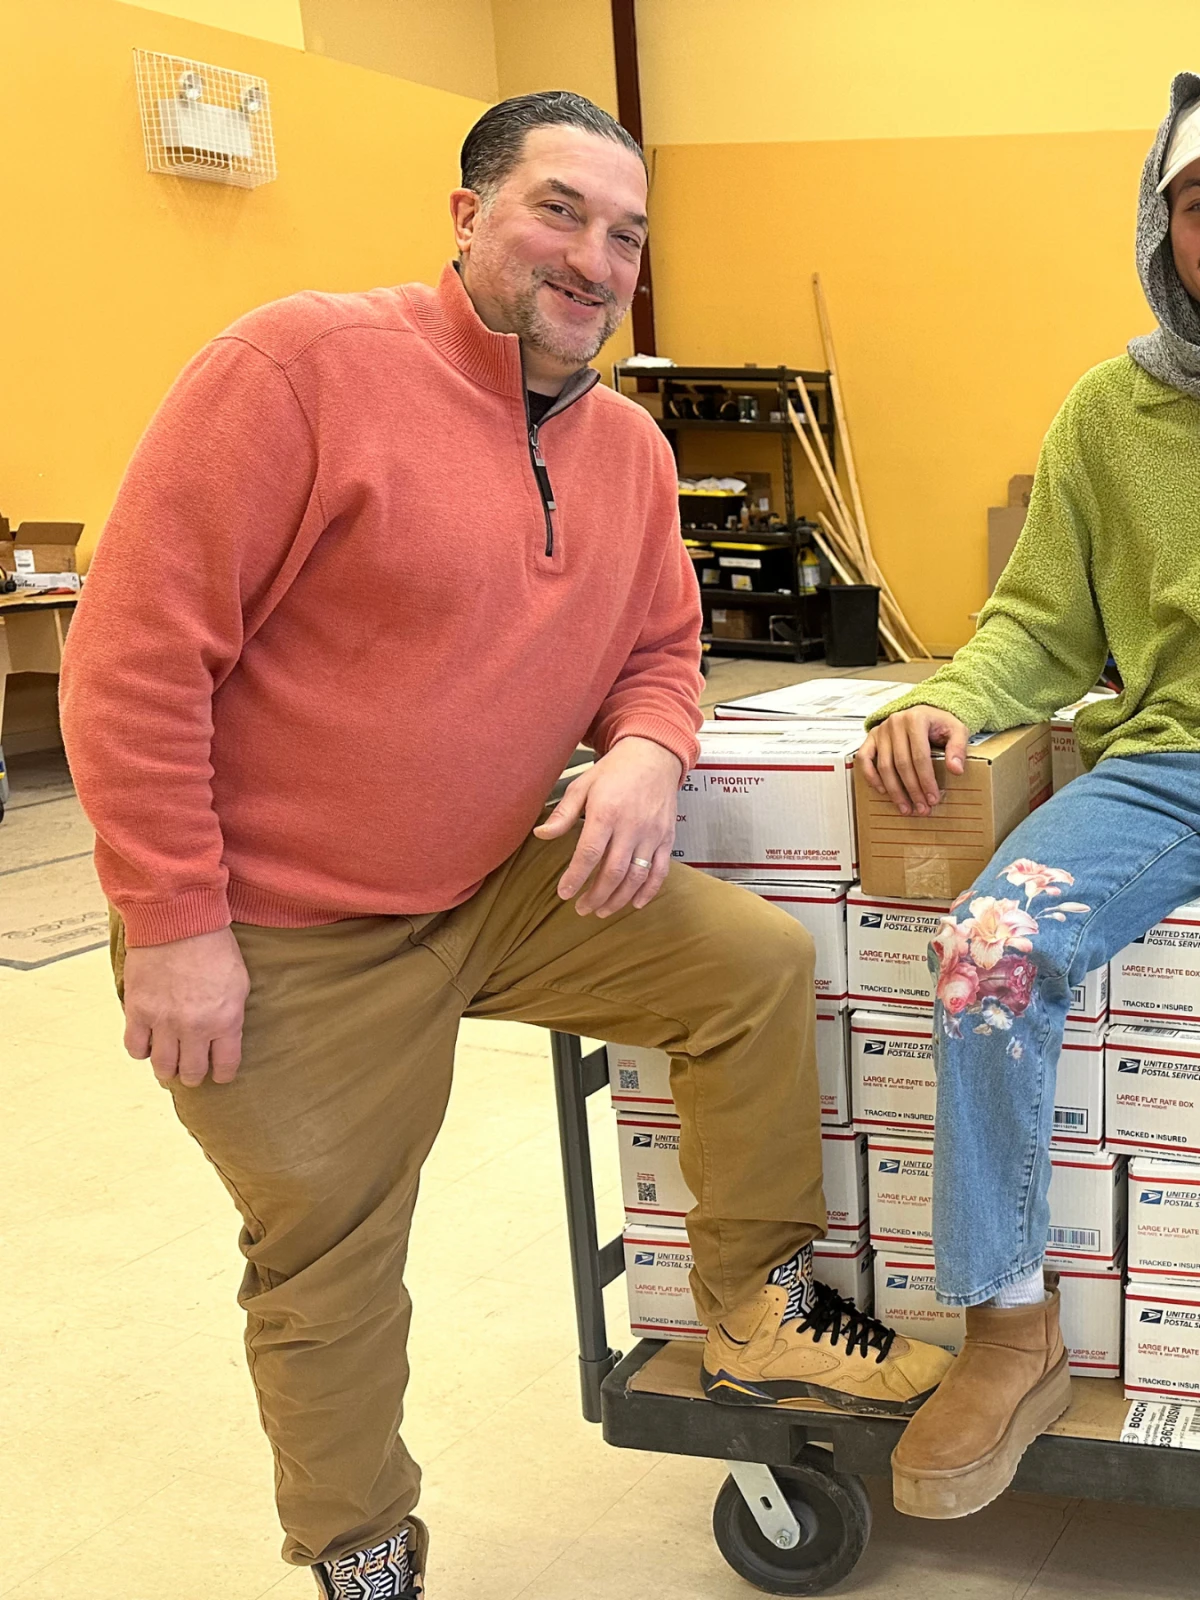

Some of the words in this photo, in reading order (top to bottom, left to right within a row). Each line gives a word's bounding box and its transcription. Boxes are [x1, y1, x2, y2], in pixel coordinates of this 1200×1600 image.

[1149, 929, 1180, 938] UNITED
[1147, 938, 1176, 947] POSTAL
[1122, 964, 1145, 972] LARGE
[861, 985, 893, 994] TRACKED
[900, 988, 930, 997] INSURED
[1144, 1060, 1174, 1069] UNITED
[1141, 1068, 1170, 1078] POSTAL
[1166, 1191, 1197, 1199] UNITED
[1164, 1199, 1193, 1208] POSTAL
[1138, 1343, 1161, 1351] LARGE
[1139, 1376, 1171, 1386] TRACKED
[1129, 1402, 1148, 1428] BOSCH
